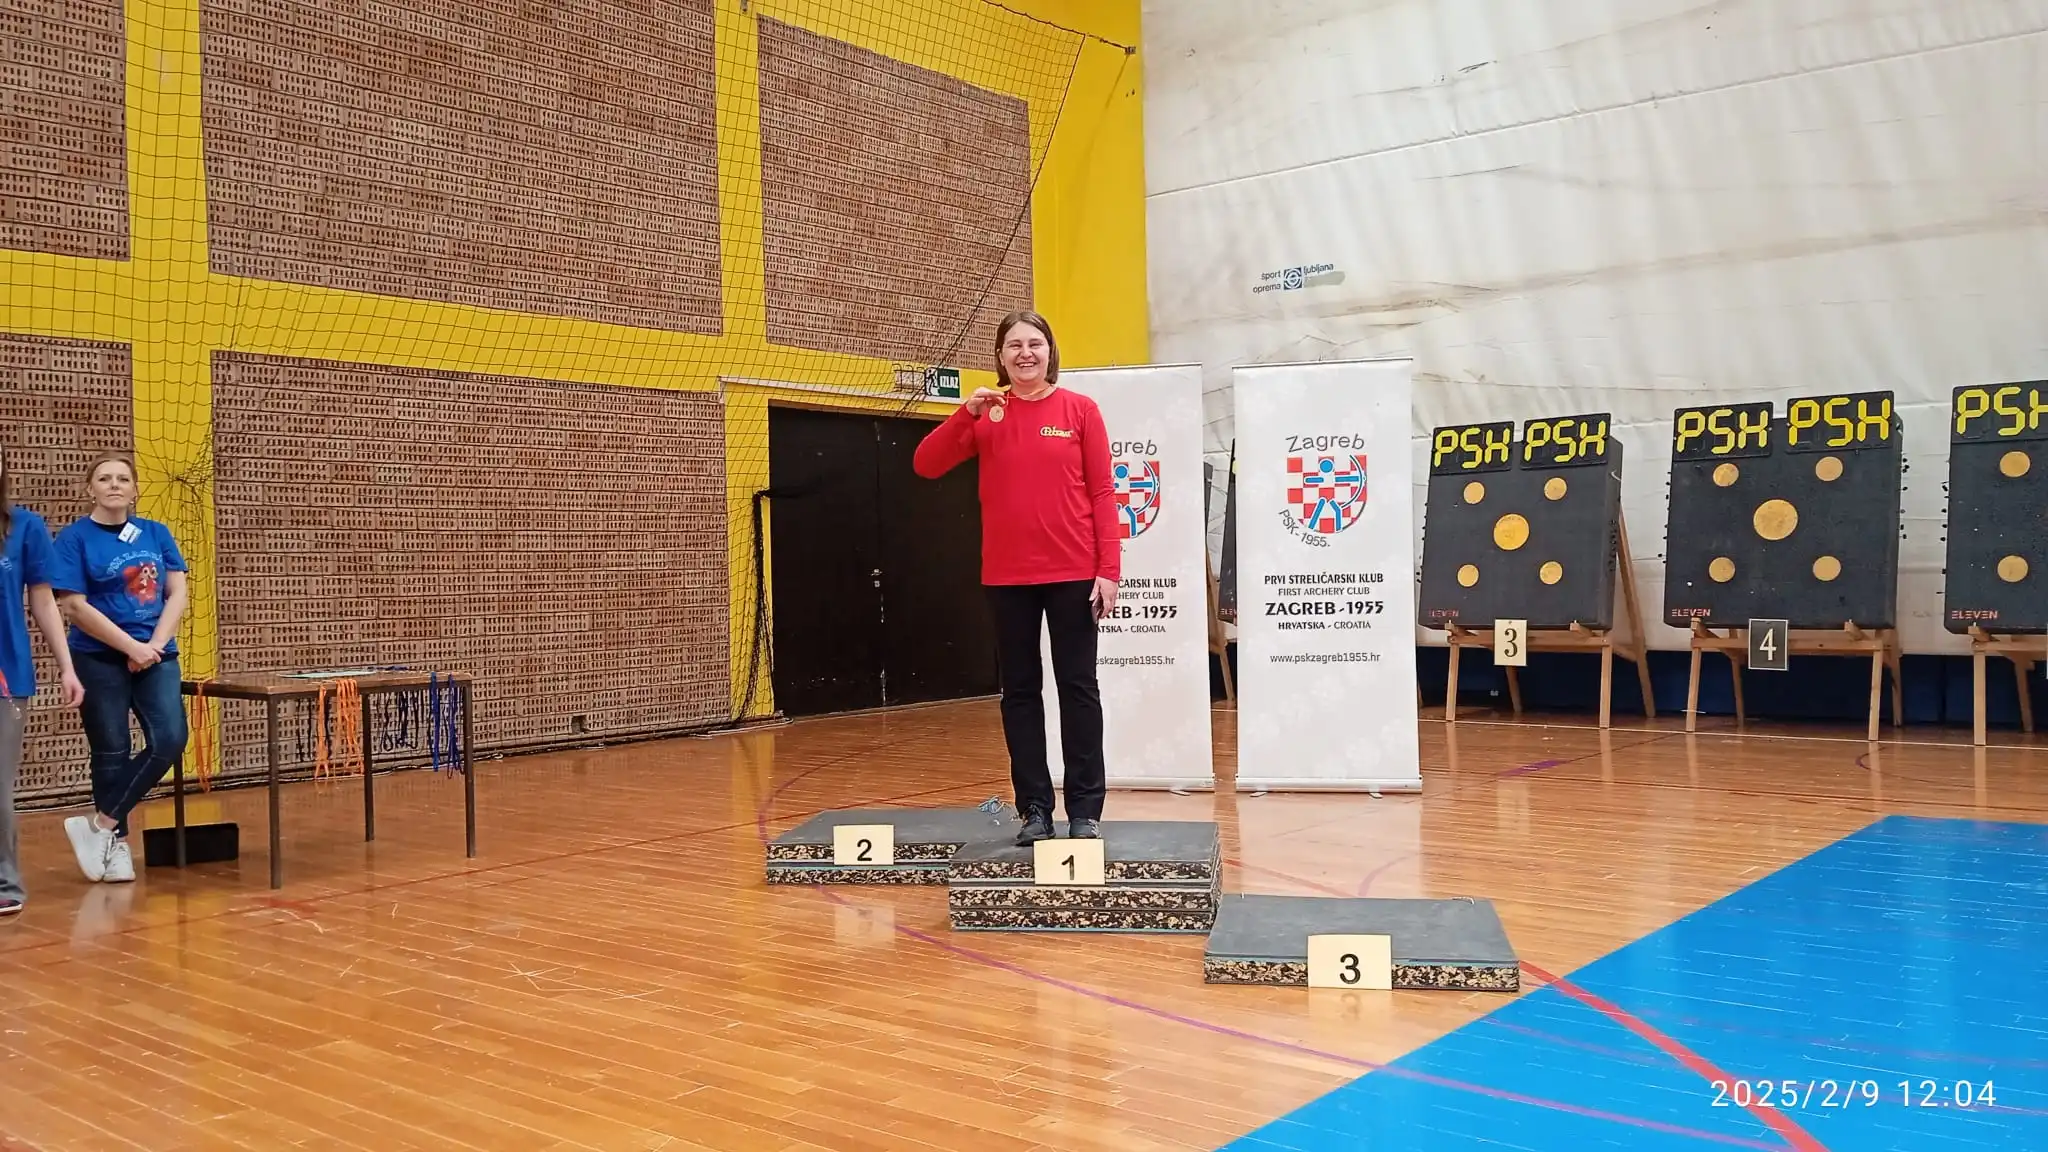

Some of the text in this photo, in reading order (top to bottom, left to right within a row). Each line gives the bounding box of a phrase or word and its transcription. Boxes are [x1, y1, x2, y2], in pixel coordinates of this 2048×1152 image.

[1261, 263, 1334, 282] šport ljubljana
[1253, 283, 1281, 294] oprema
[940, 375, 959, 388] IZLAZ
[1285, 433, 1365, 453] Zagreb
[1154, 577, 1177, 588] KLUB
[1264, 571, 1384, 585] PRVI STRELIČARSKI KLUB
[1117, 591, 1164, 600] HERY CLUB
[1278, 587, 1370, 596] FIRST ARCHERY CLUB
[1142, 605, 1177, 619] 1955
[1265, 602, 1336, 616] ZAGREB
[1346, 601, 1384, 615] 1955
[1672, 608, 1711, 617] ELEVEN
[1952, 610, 1998, 619] ELEVEN
[1130, 625, 1166, 633] CROATIA
[1278, 621, 1325, 630] HRVATSKA
[1333, 620, 1371, 630] CROATIA
[1504, 628, 1518, 657] 3
[1759, 628, 1777, 661] 4
[1270, 652, 1381, 664] www.pskzagreb1955.hr
[857, 838, 872, 861] 2
[1061, 854, 1075, 880] 1
[1339, 953, 1361, 985] 3
